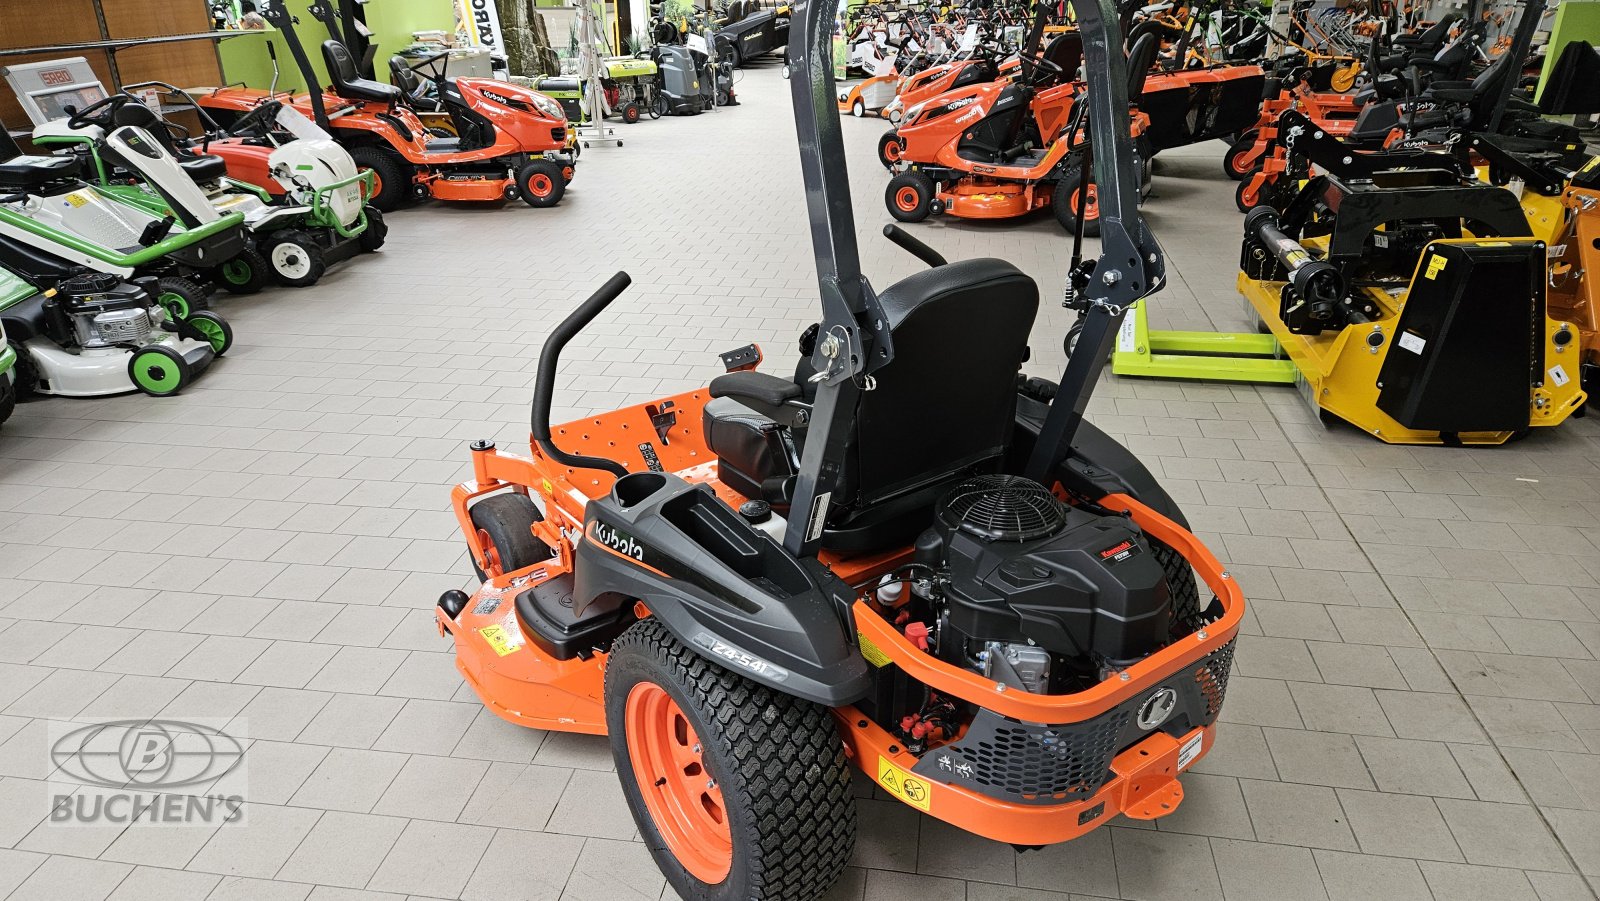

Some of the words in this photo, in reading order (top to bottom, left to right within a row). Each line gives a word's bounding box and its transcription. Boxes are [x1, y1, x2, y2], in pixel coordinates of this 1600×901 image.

[40, 69, 71, 84] SABO
[483, 90, 508, 104] Kubota
[947, 97, 974, 110] Kubota
[1403, 140, 1429, 148] Kubota
[595, 520, 644, 561] Kubota
[1100, 540, 1131, 558] Kawasaki
[711, 640, 768, 674] Z4-541
